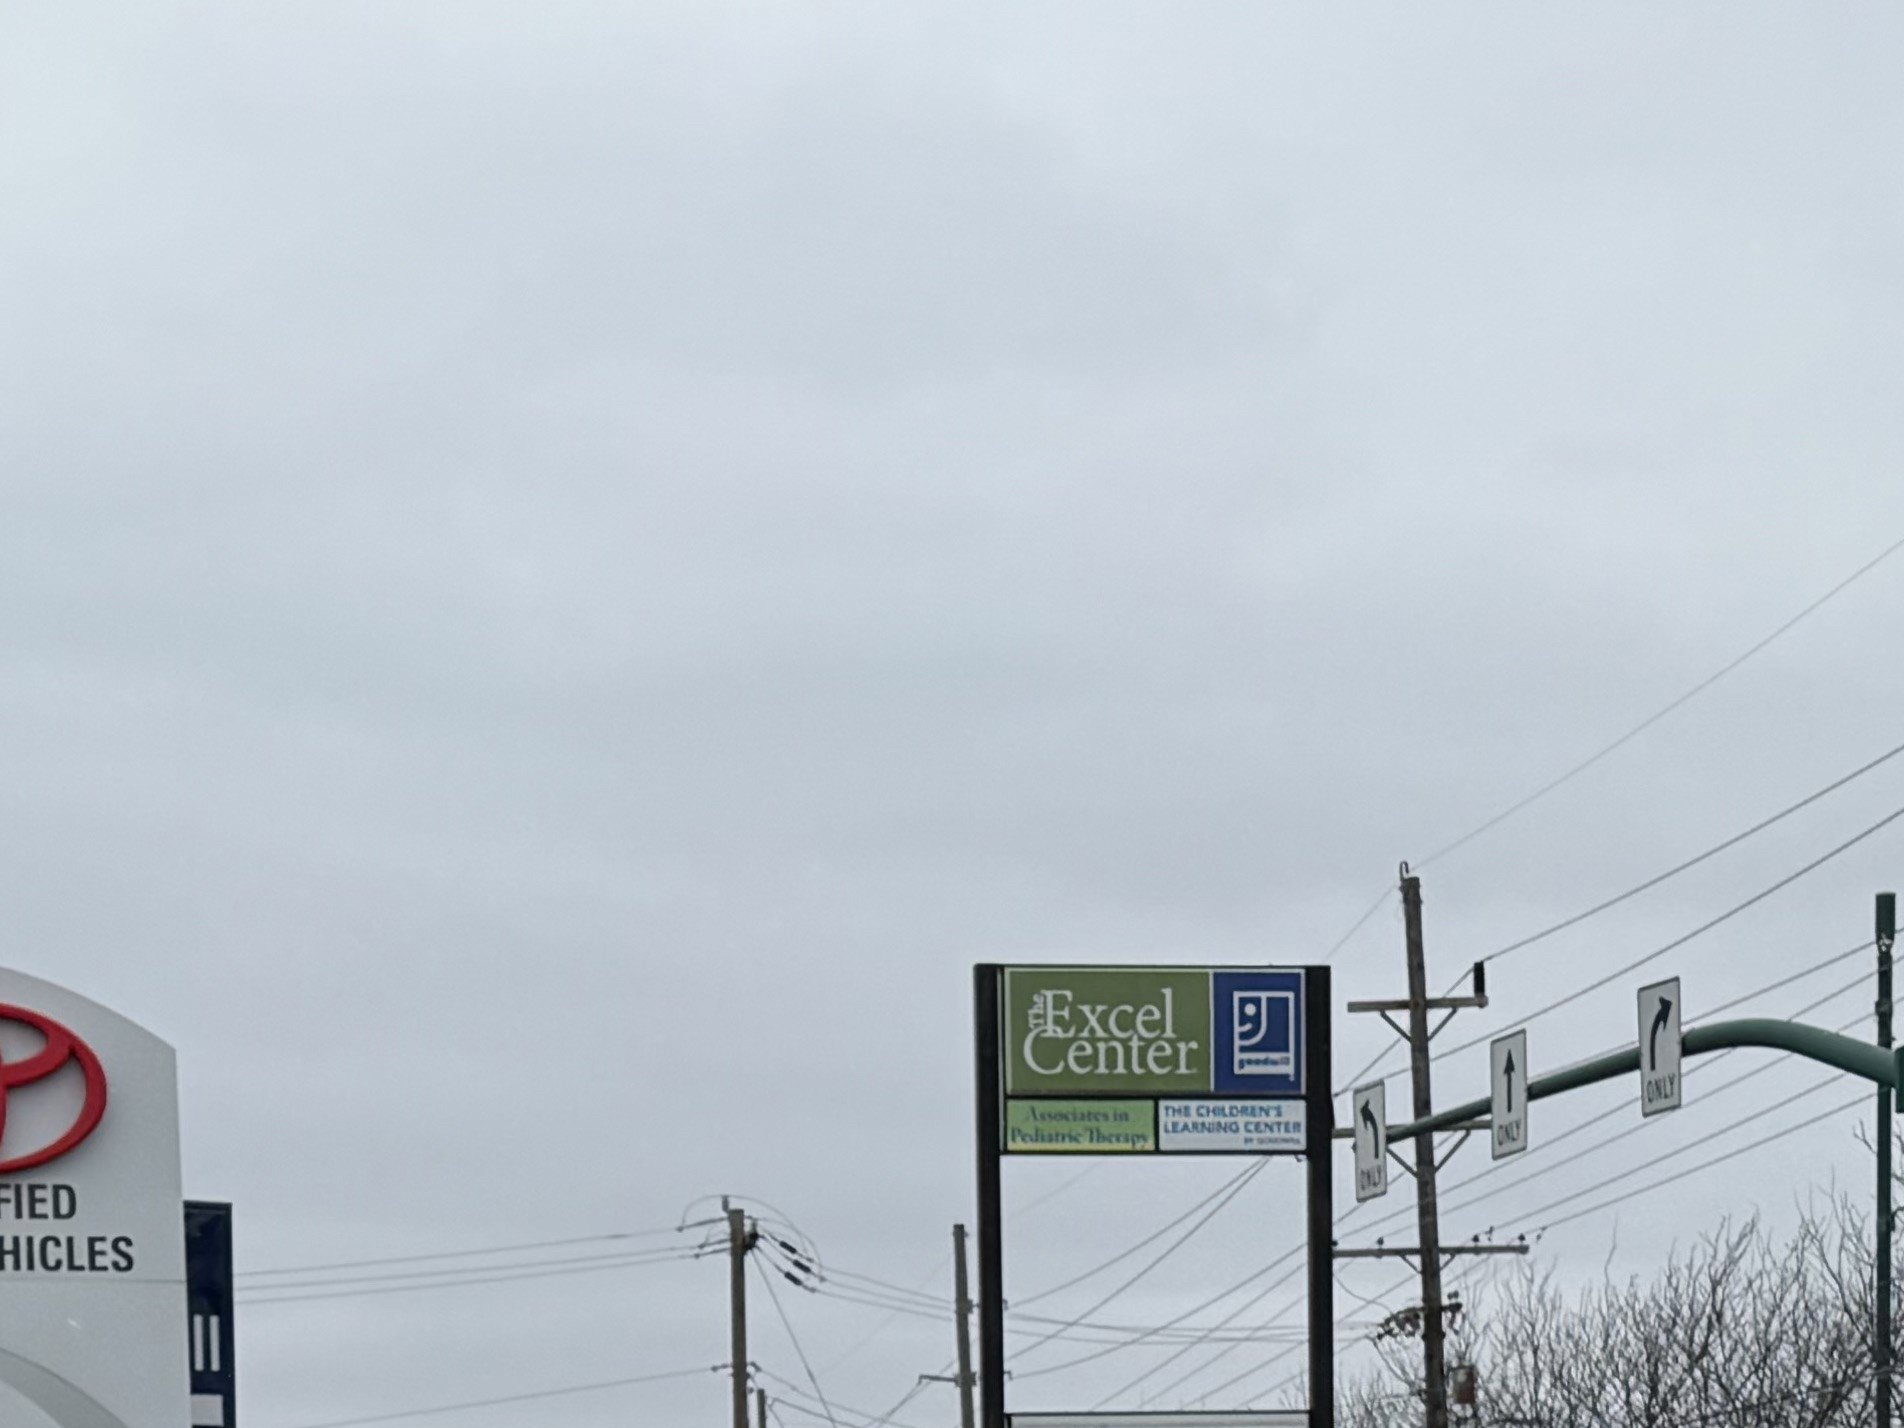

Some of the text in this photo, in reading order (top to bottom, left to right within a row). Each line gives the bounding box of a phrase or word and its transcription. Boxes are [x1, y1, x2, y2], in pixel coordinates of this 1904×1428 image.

[1040, 987, 1178, 1039] Excel
[1023, 1026, 1199, 1075] Center
[1645, 1073, 1676, 1104] ONLY
[1026, 1104, 1130, 1123] Associates in
[1163, 1104, 1283, 1118] THE CHILDREN'S
[1010, 1126, 1148, 1150] Pediatric Therapy
[1163, 1120, 1302, 1134] LEARNING CENTER
[1496, 1118, 1522, 1147] ONLY
